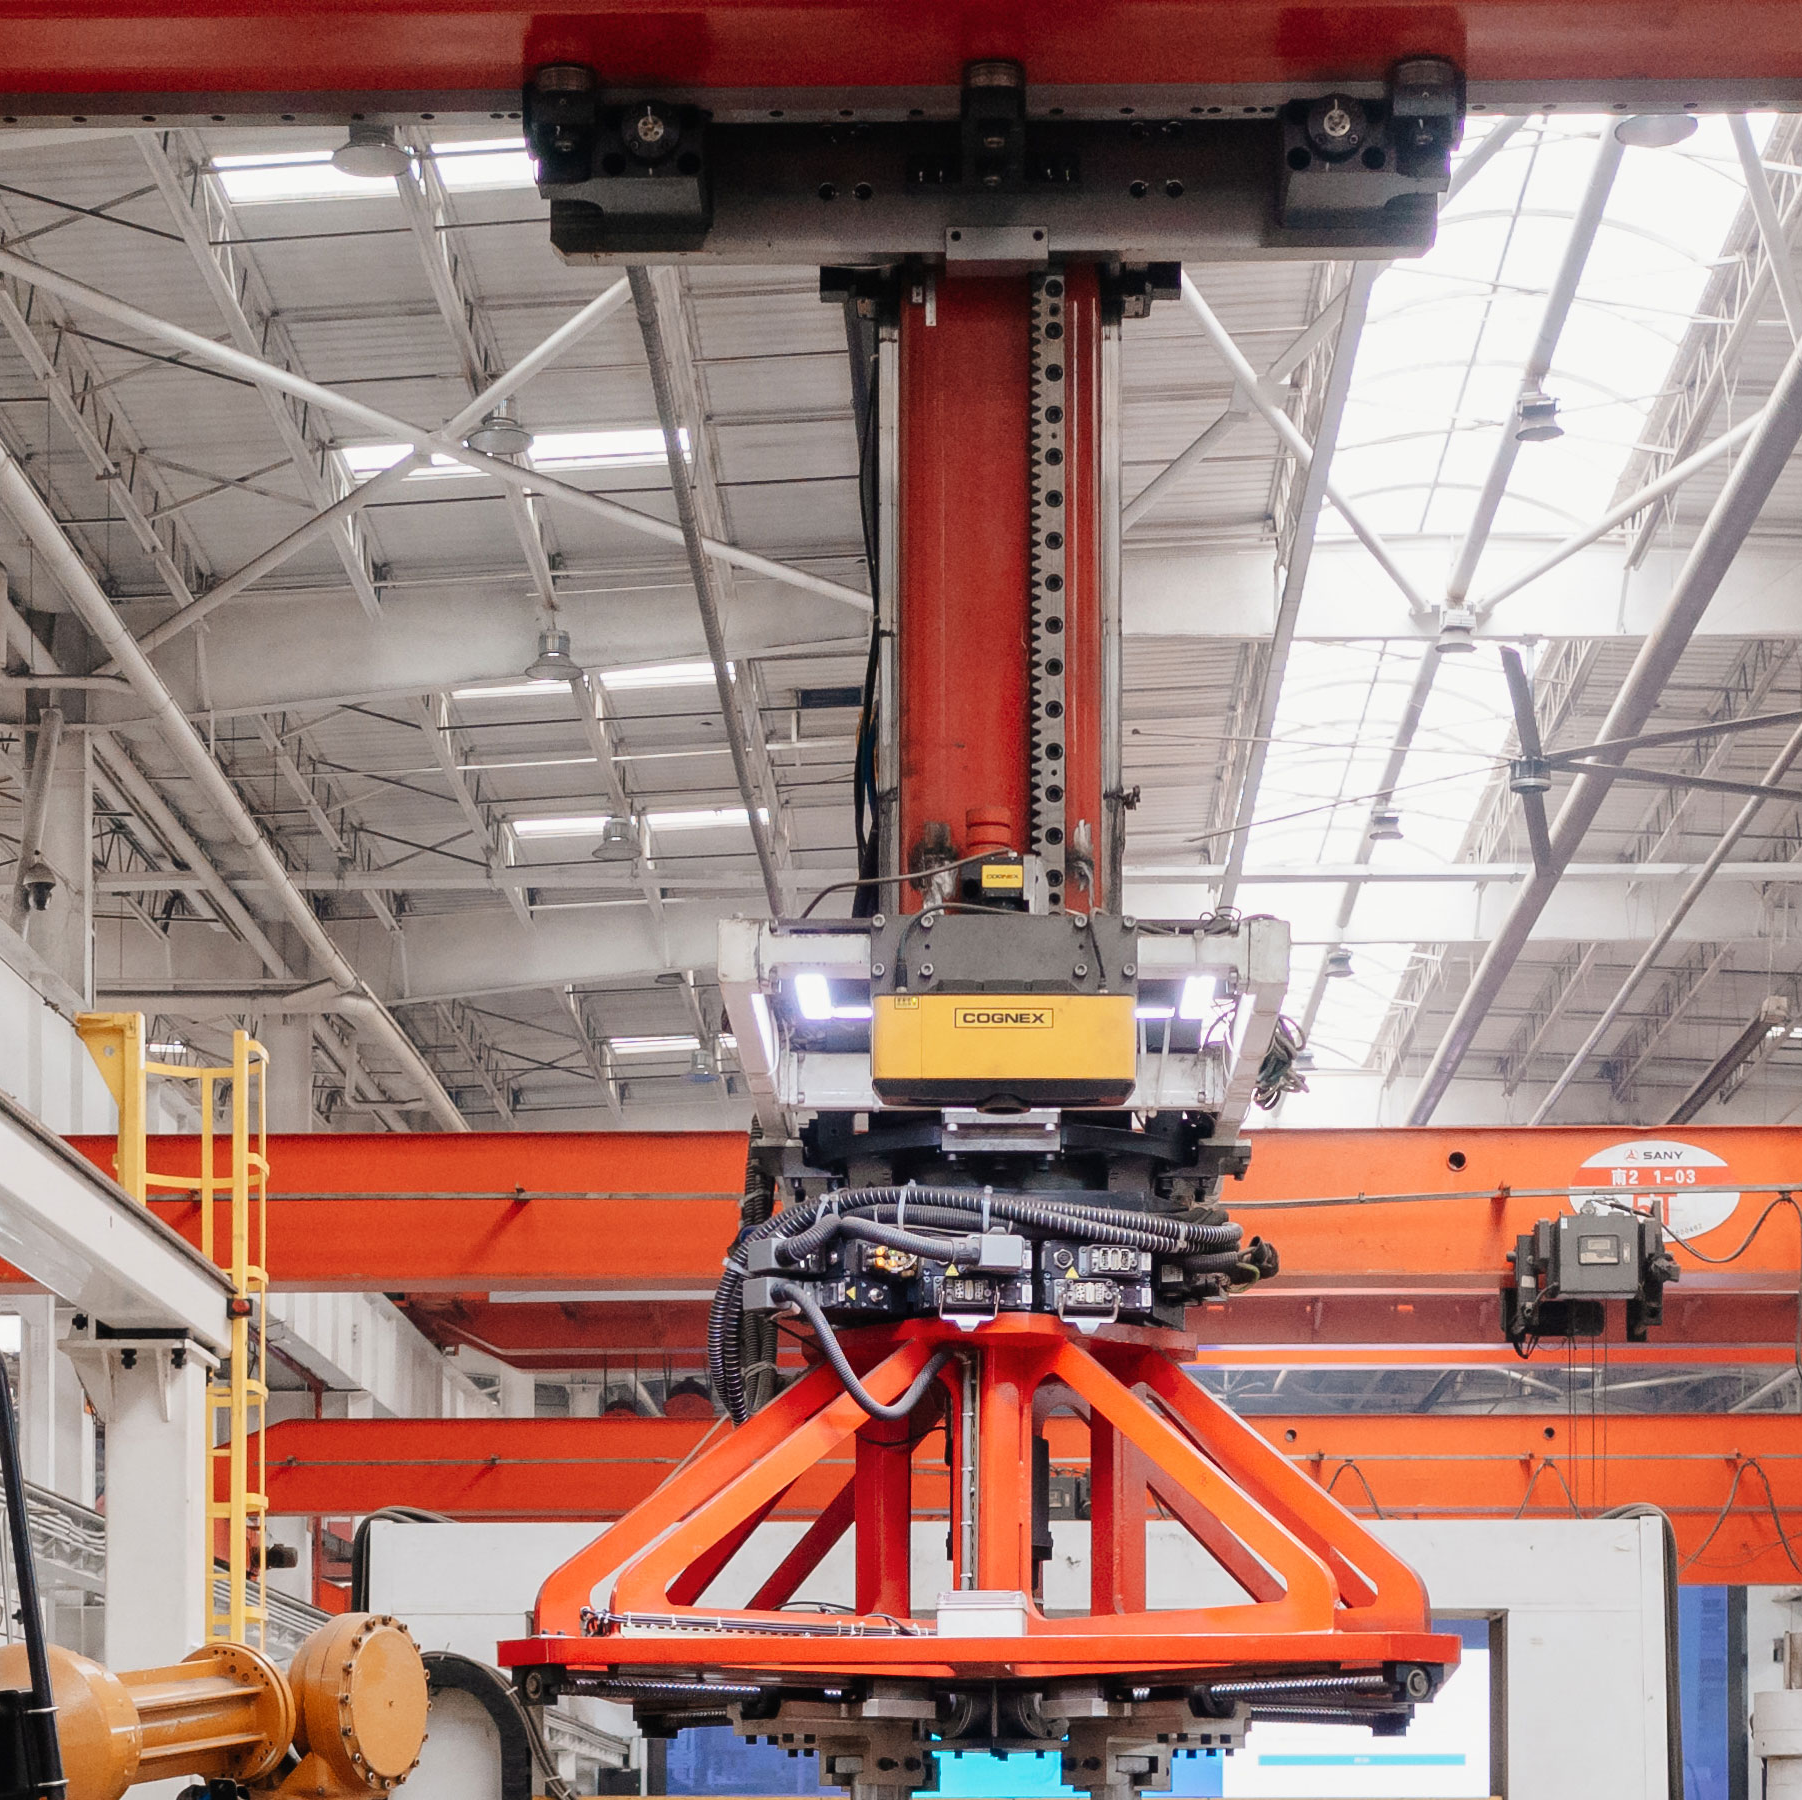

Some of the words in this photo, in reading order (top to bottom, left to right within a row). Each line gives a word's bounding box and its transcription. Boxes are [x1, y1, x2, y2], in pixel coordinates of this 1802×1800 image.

[985, 872, 1019, 881] COGNEX
[962, 1012, 1045, 1024] COGNEX
[1643, 1151, 1684, 1160] SANY
[1611, 1168, 1639, 1186] 南2
[1653, 1169, 1696, 1185] 1-03
